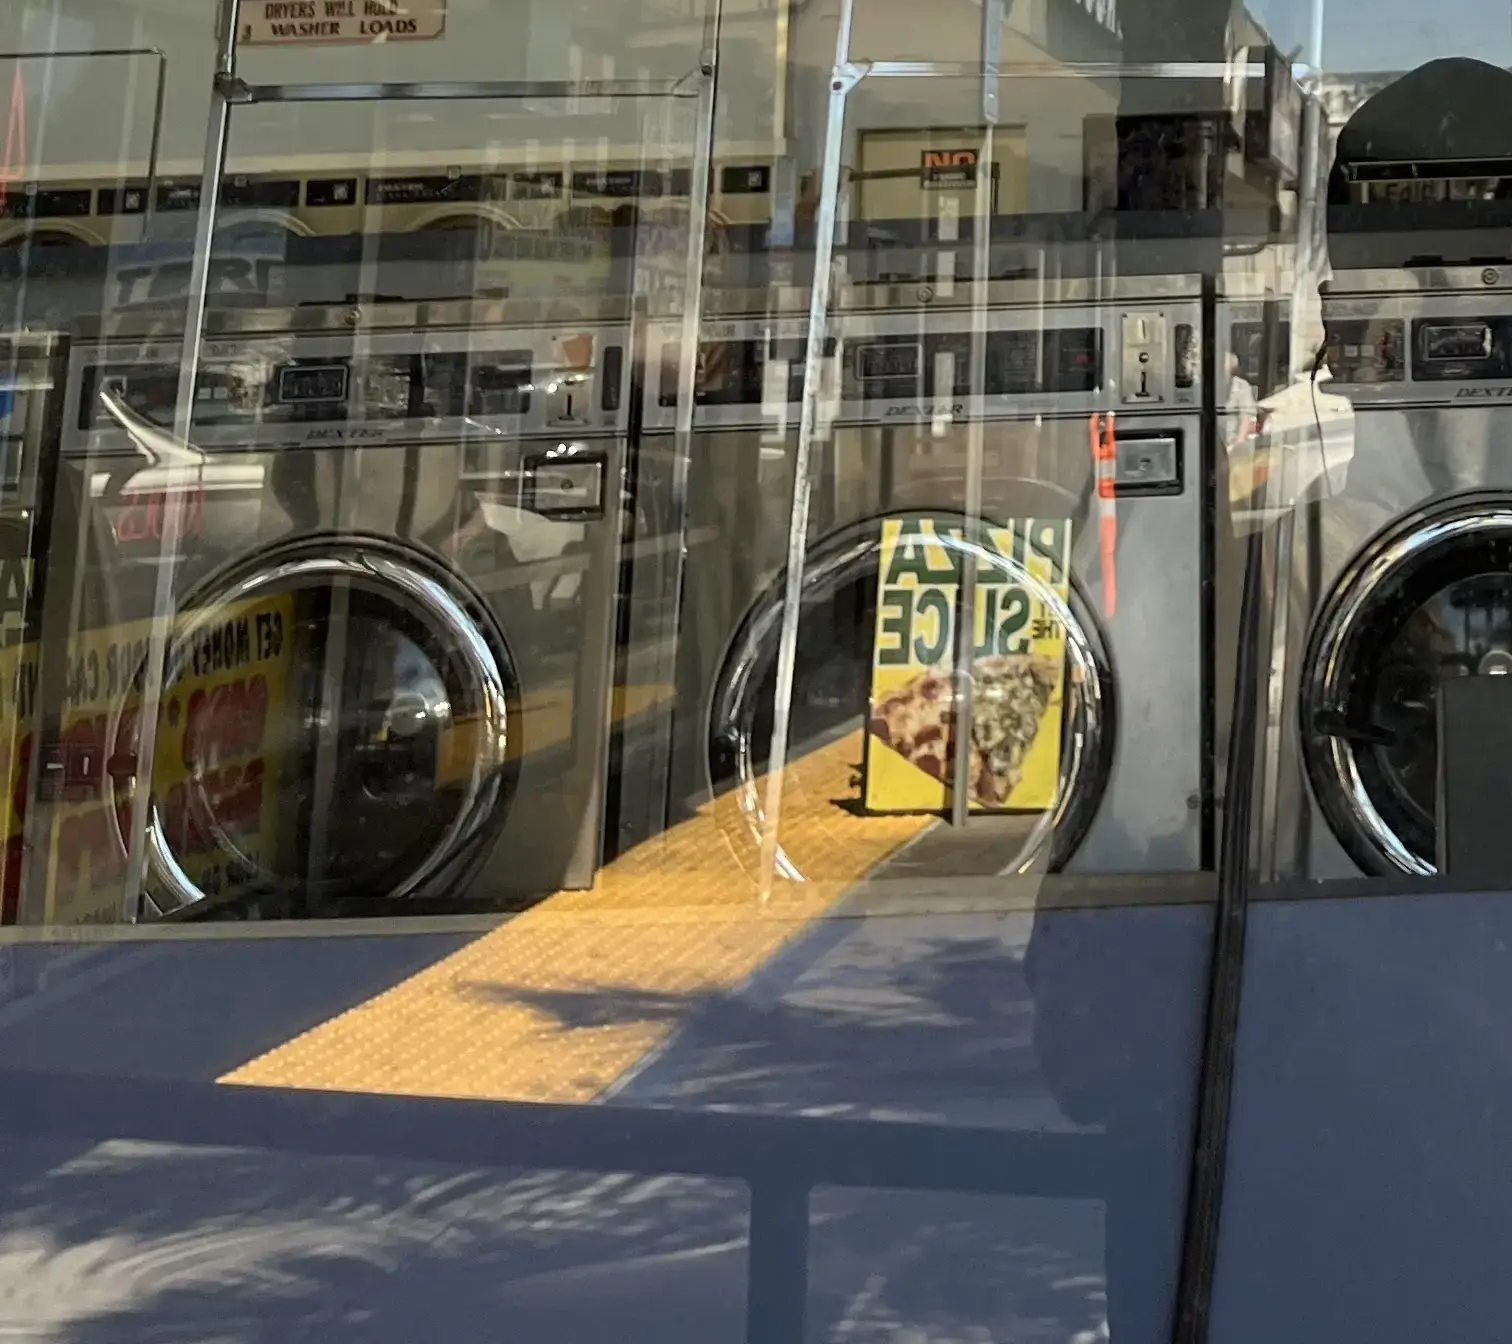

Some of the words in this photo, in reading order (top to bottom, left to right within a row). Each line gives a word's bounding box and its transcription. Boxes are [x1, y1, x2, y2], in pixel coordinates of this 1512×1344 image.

[264, 0, 316, 20] DRYERS
[270, 20, 341, 37] WASHER
[359, 18, 418, 35] LOADS
[924, 151, 976, 168] NO
